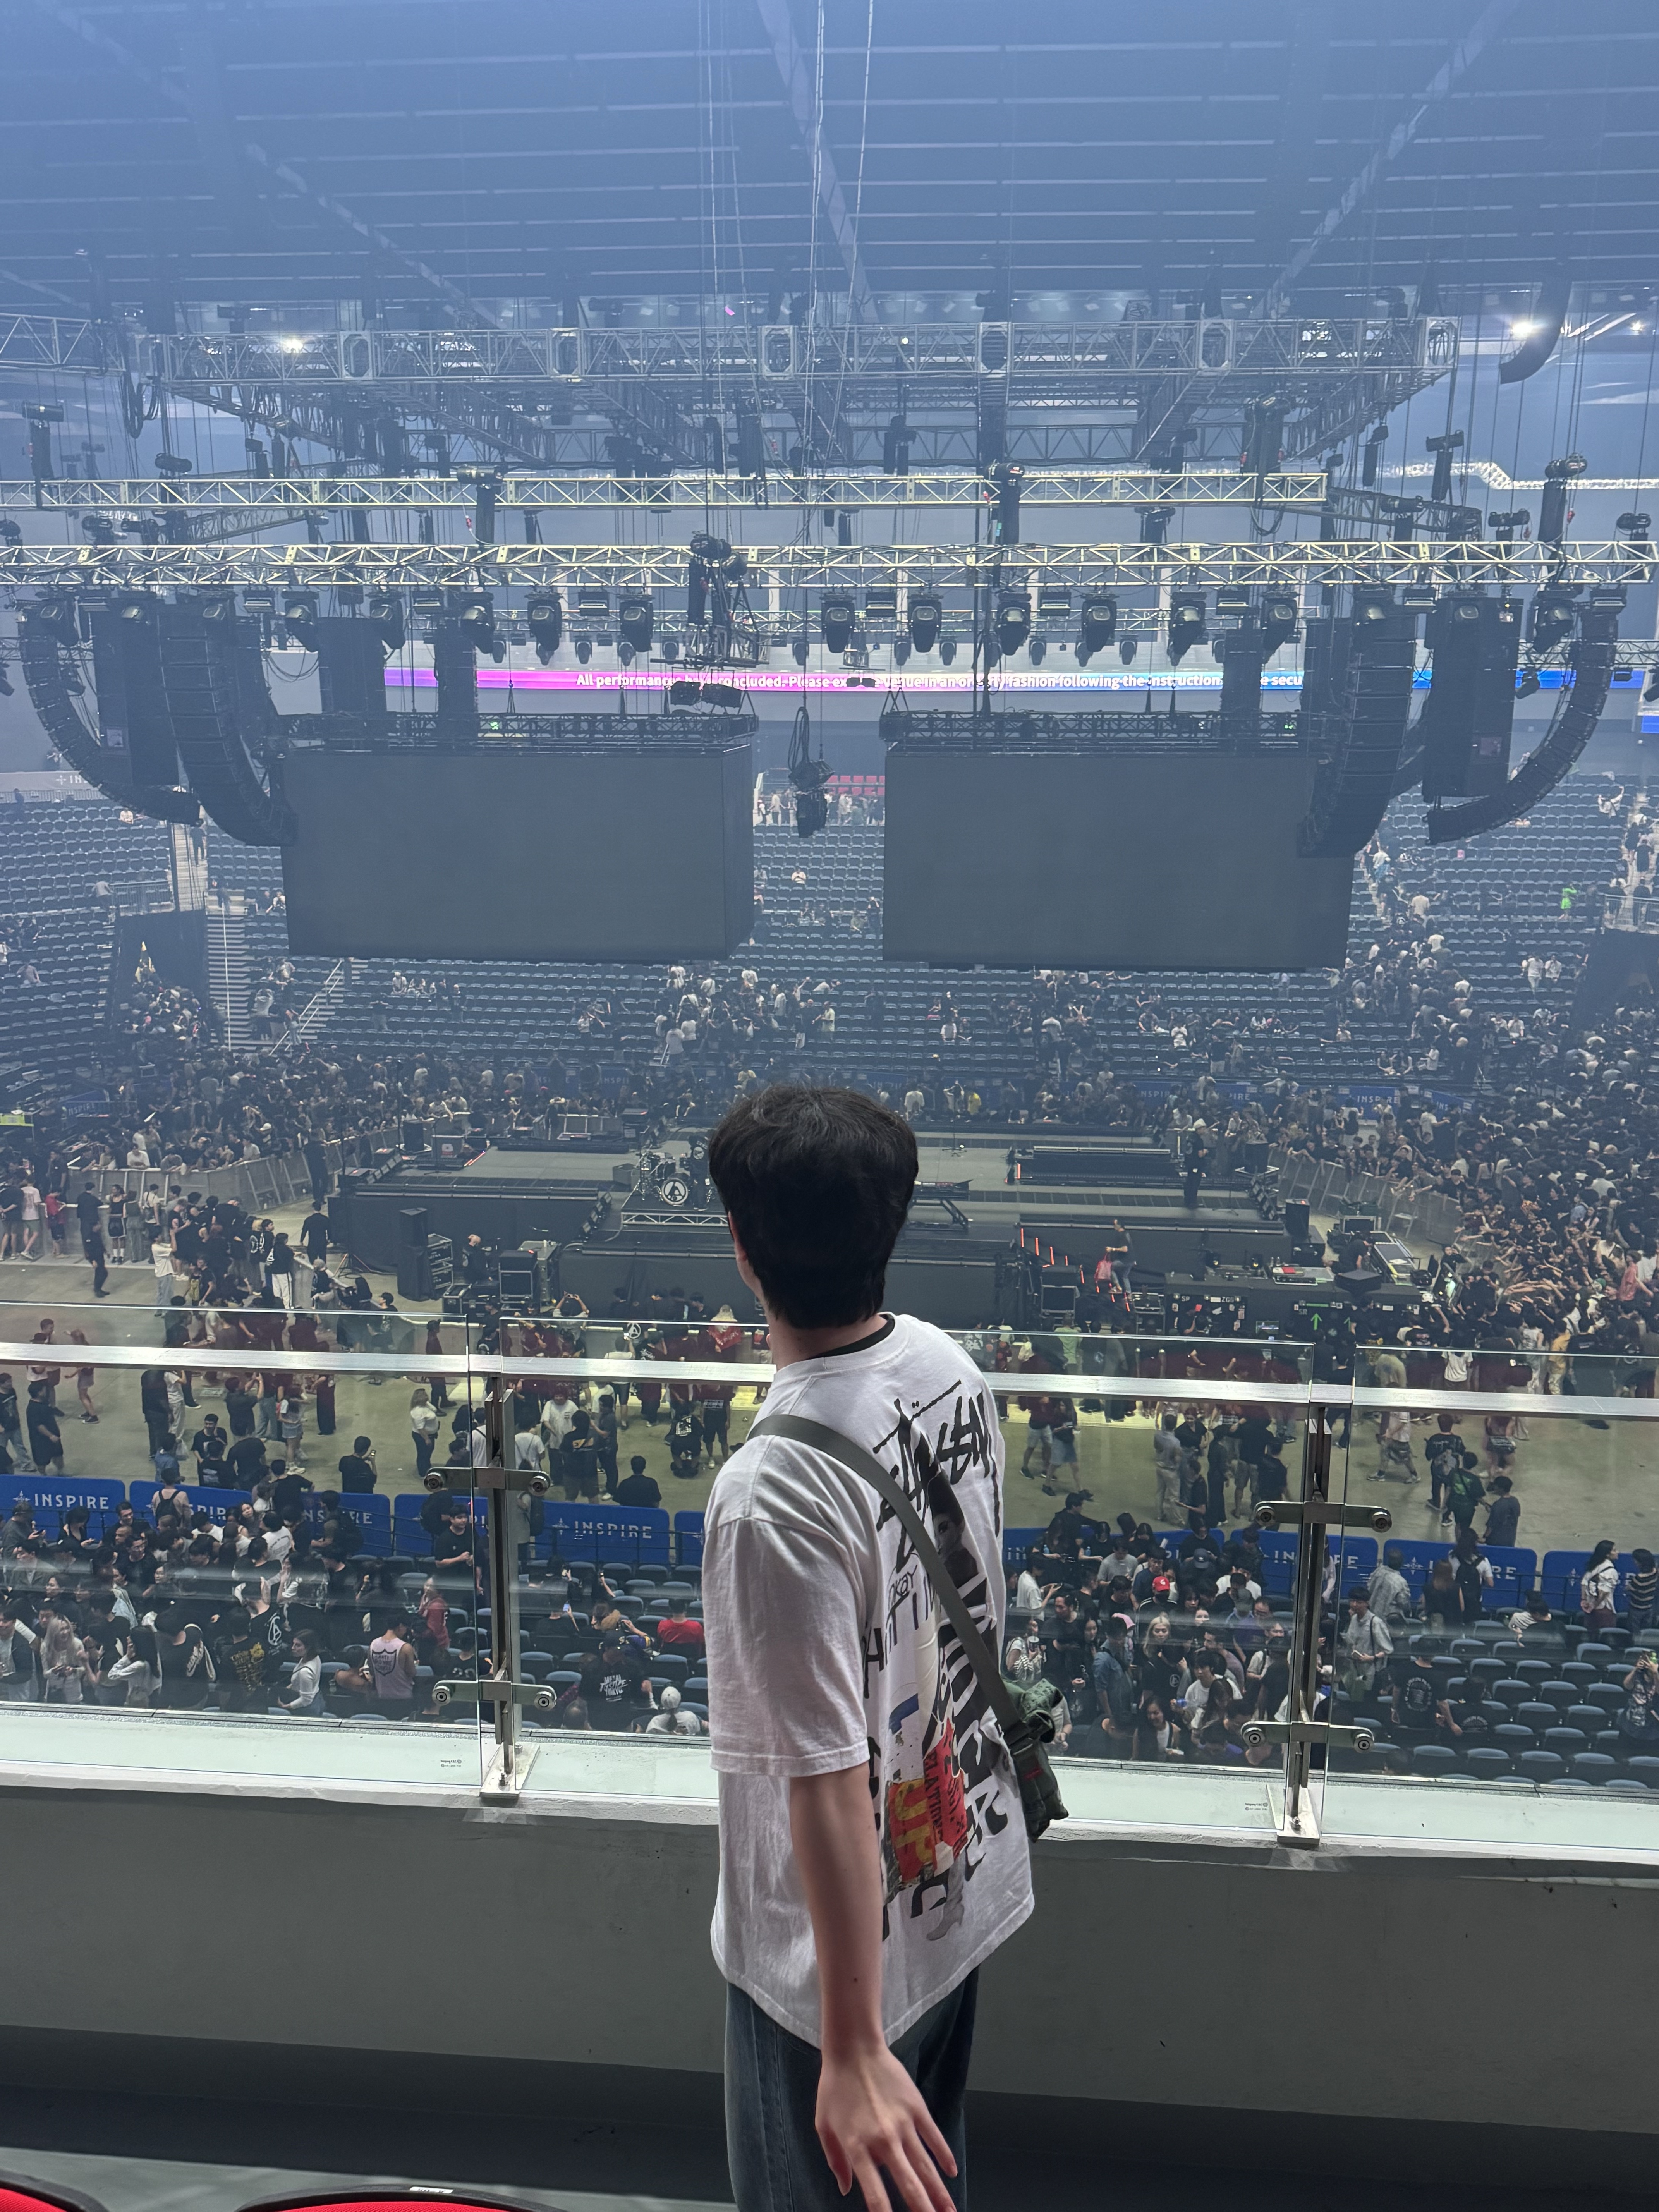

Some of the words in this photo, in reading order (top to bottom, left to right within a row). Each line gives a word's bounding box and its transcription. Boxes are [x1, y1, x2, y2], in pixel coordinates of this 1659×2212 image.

[576, 674, 594, 685] All
[788, 675, 829, 687] Please
[883, 678, 922, 688] venue
[924, 677, 938, 687] in
[939, 678, 956, 687] an
[1009, 675, 1056, 687] fashion
[1059, 674, 1120, 690] following
[1123, 675, 1145, 687] the
[1271, 676, 1303, 686] secu
[34, 1493, 109, 1510] INSPIRE
[574, 1521, 652, 1539] INSPIRE
